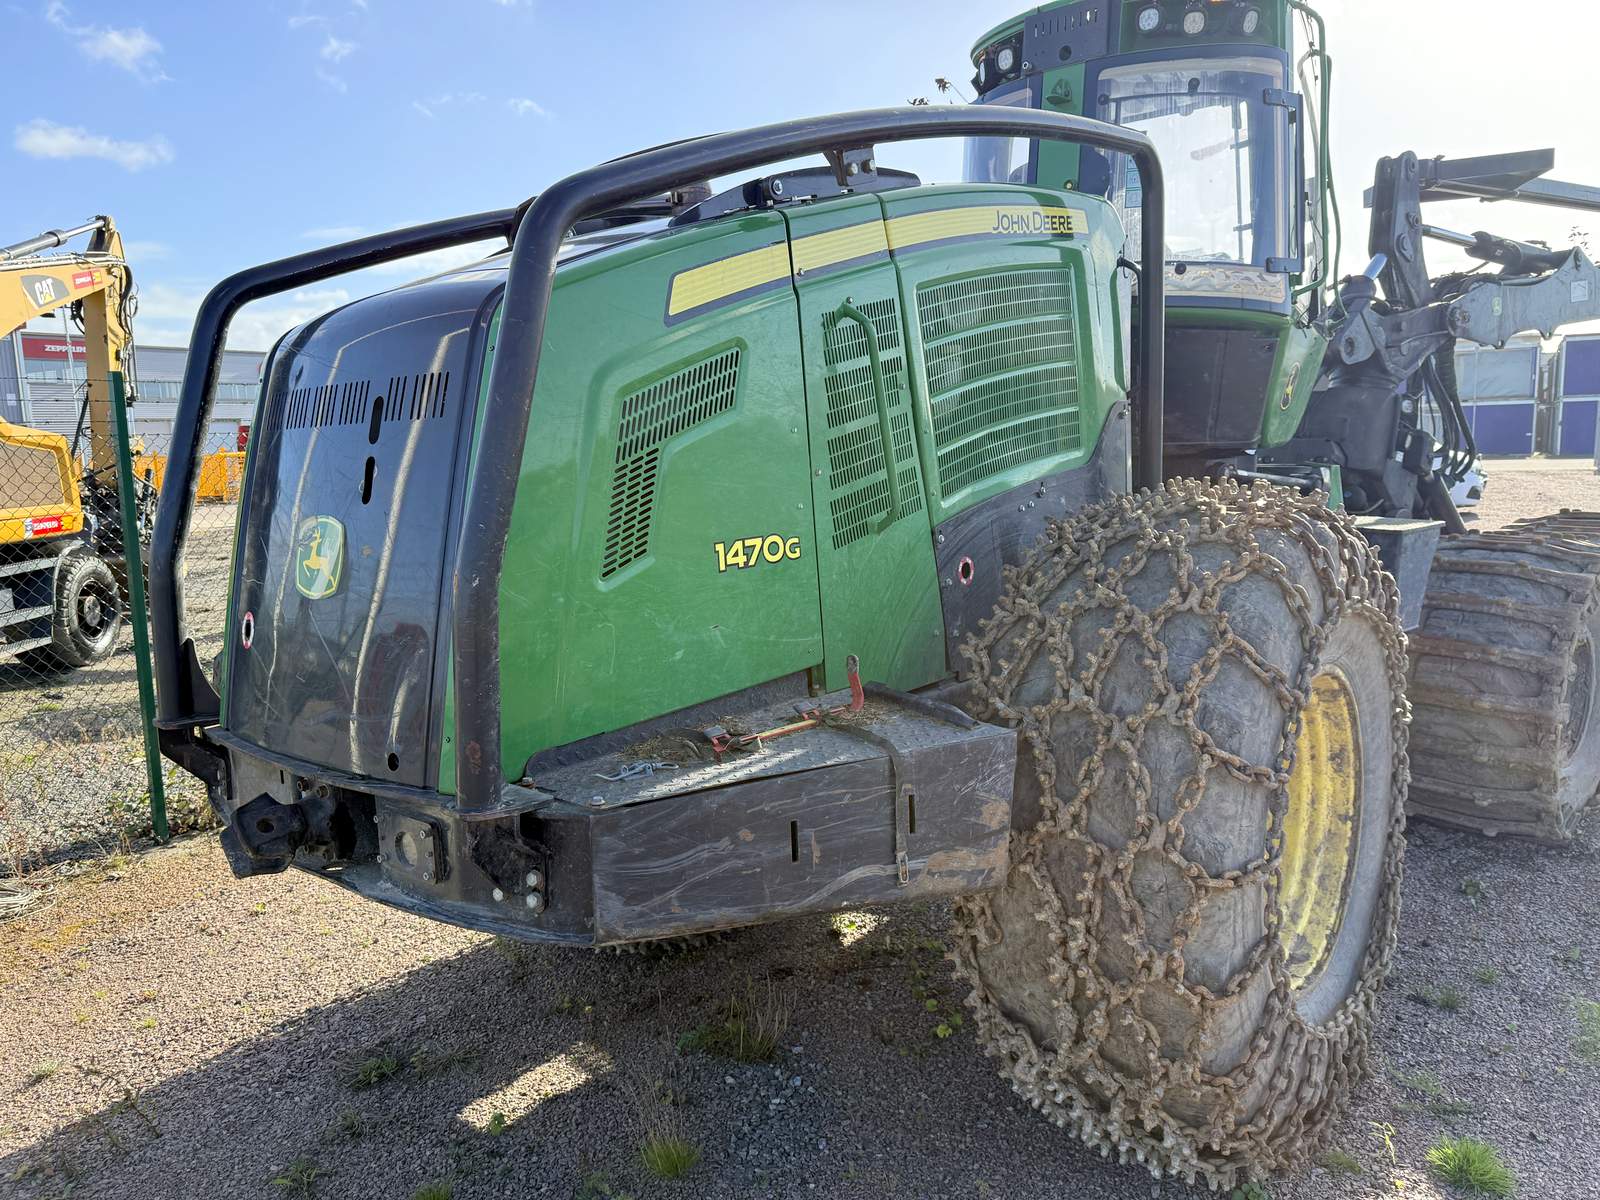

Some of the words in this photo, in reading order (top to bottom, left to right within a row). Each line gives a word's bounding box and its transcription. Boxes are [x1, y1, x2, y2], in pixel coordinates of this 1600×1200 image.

[992, 209, 1030, 232] JOHN
[1032, 211, 1074, 231] DEERE
[34, 277, 57, 305] CAT
[44, 344, 86, 353] ZEPPLIN
[714, 533, 801, 573] 1470G
